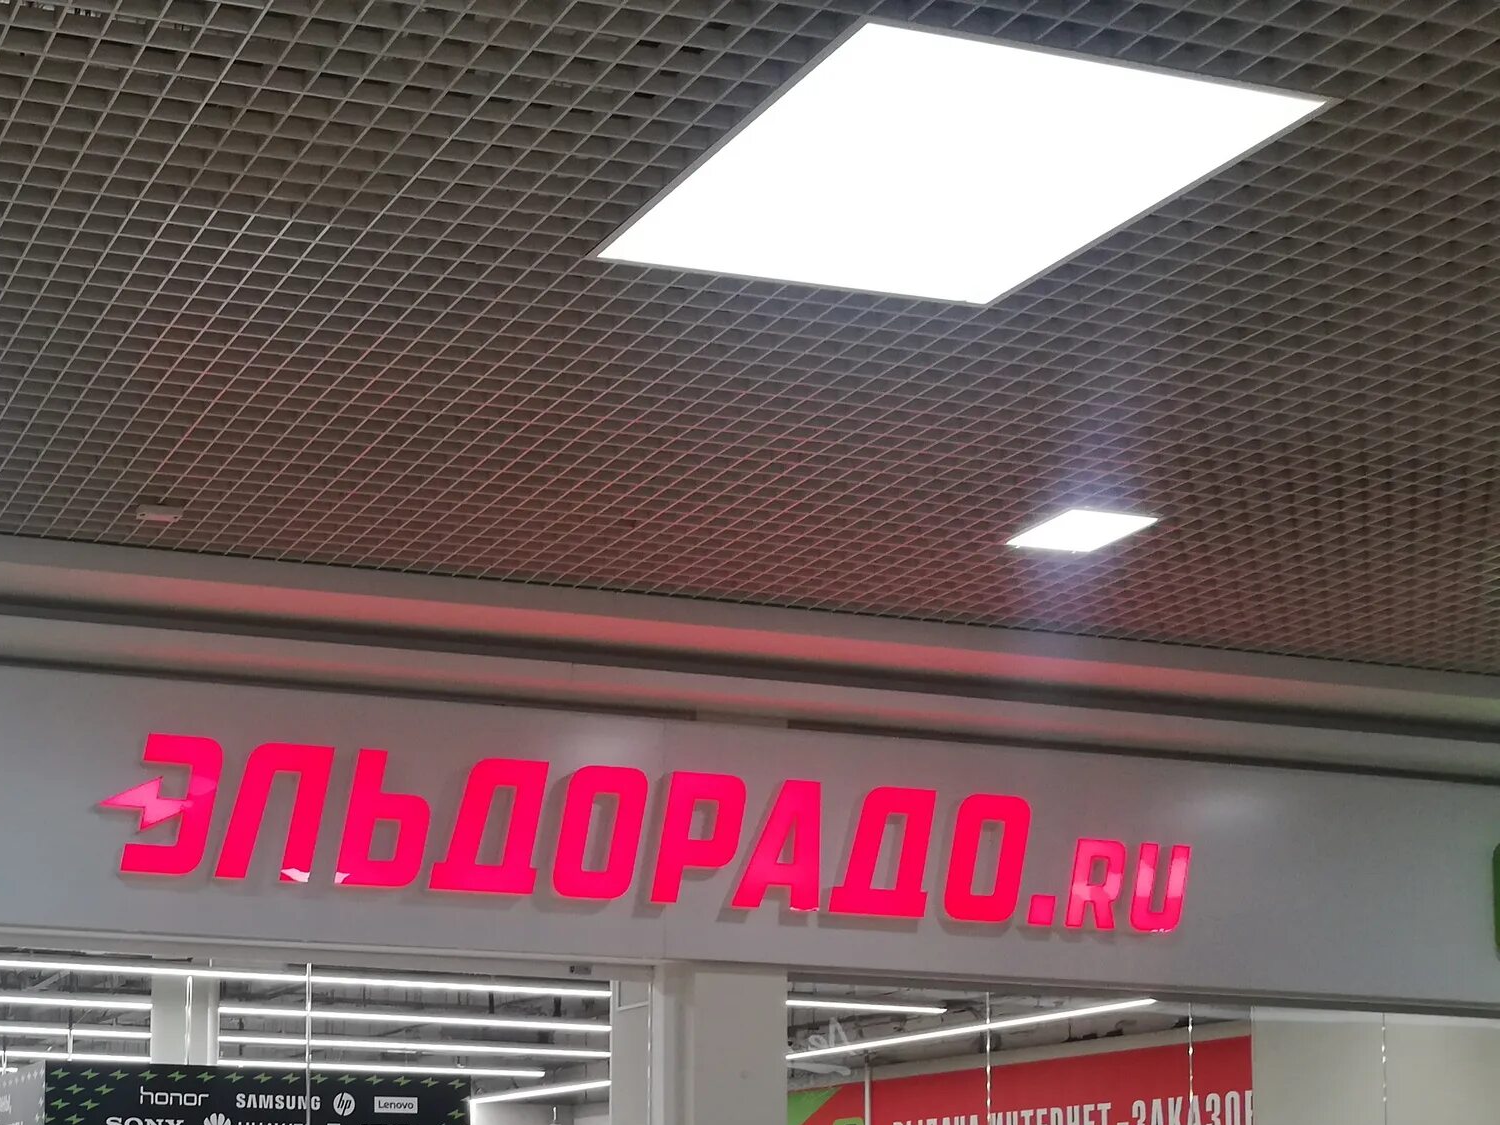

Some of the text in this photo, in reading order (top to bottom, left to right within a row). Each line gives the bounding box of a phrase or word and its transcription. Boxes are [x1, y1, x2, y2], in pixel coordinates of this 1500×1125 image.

[140, 1085, 414, 1116] honor SAMSUNG hp Lenovo
